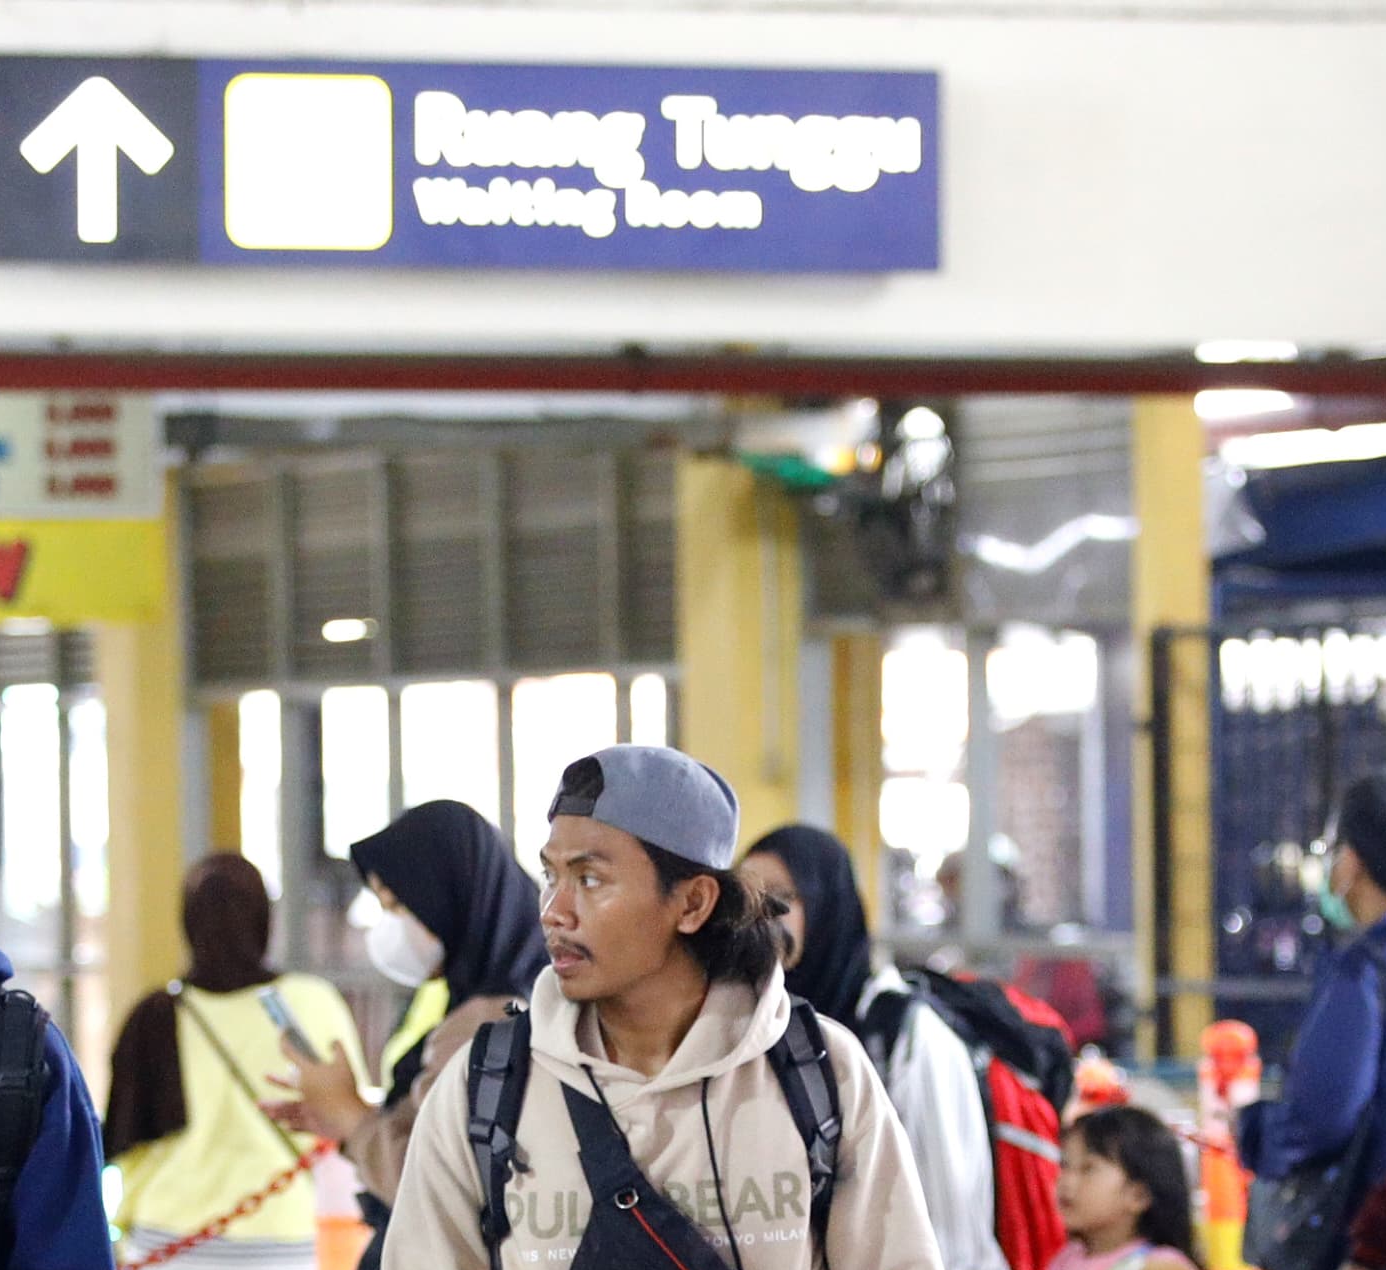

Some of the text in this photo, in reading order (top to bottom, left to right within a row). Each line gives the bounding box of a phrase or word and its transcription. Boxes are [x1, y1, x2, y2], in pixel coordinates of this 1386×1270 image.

[414, 91, 921, 191] Ruang Tunggu
[413, 176, 762, 238] Waiting Room
